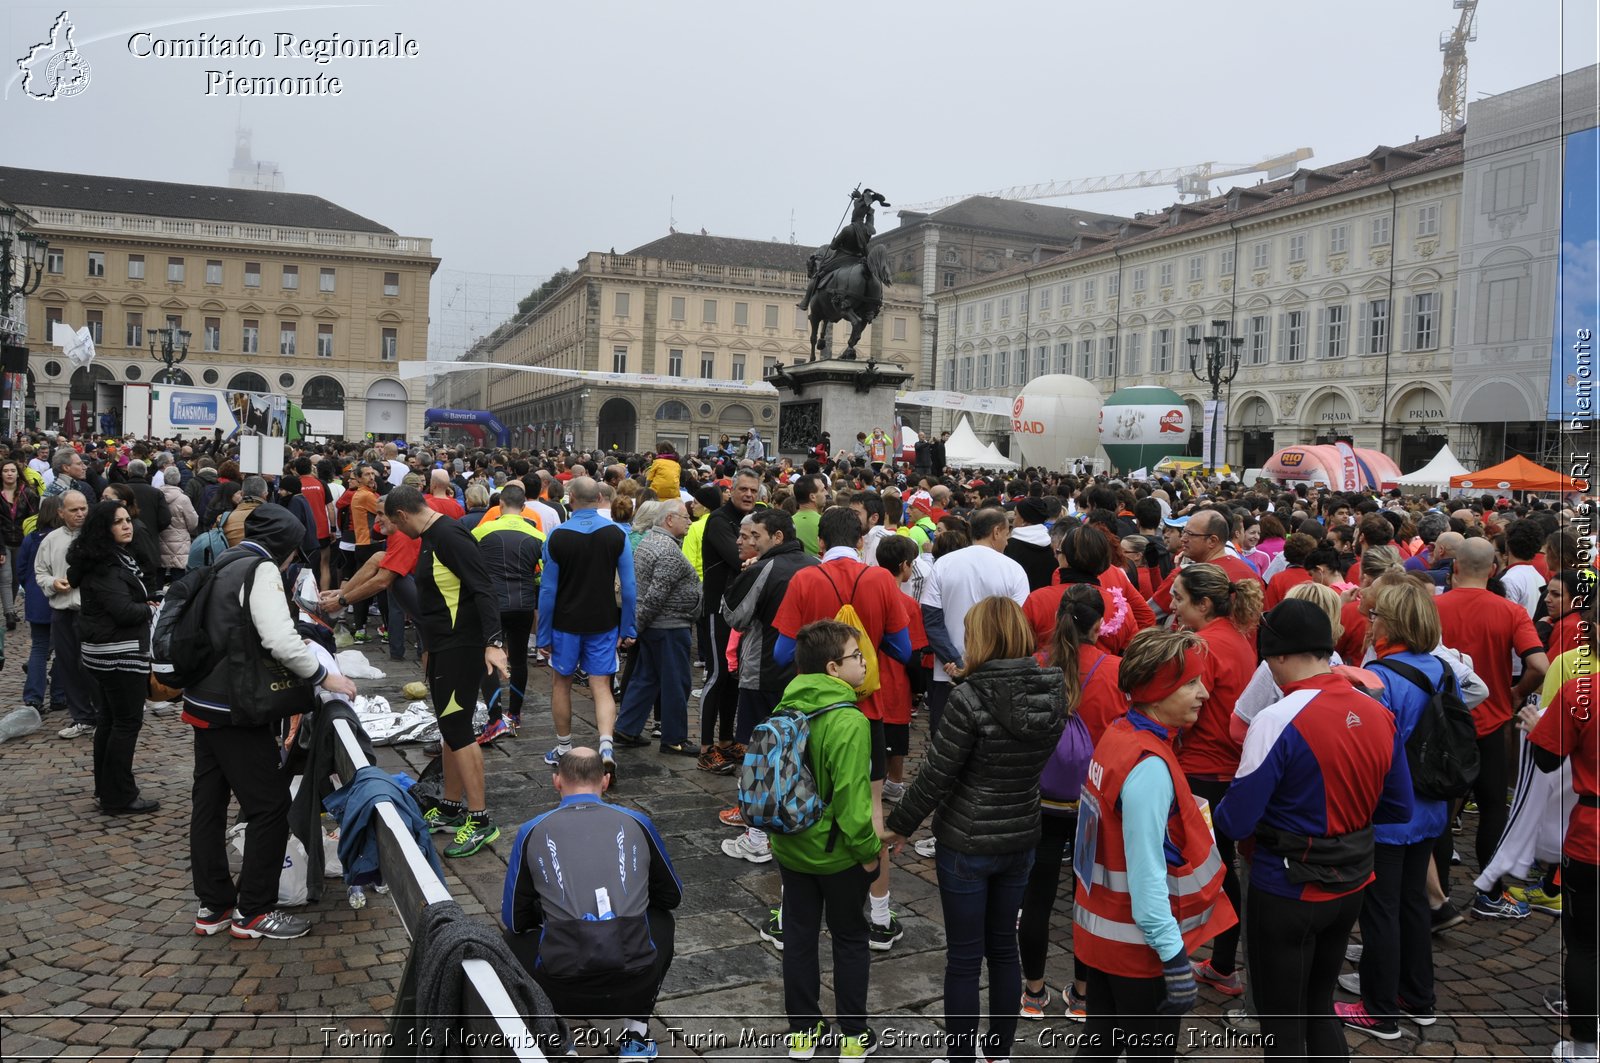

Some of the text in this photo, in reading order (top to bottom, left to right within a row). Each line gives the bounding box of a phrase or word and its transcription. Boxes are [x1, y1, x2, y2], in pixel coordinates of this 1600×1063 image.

[449, 412, 477, 420] Bavaria
[1409, 410, 1444, 419] PRADA
[1282, 453, 1303, 462] RIO
